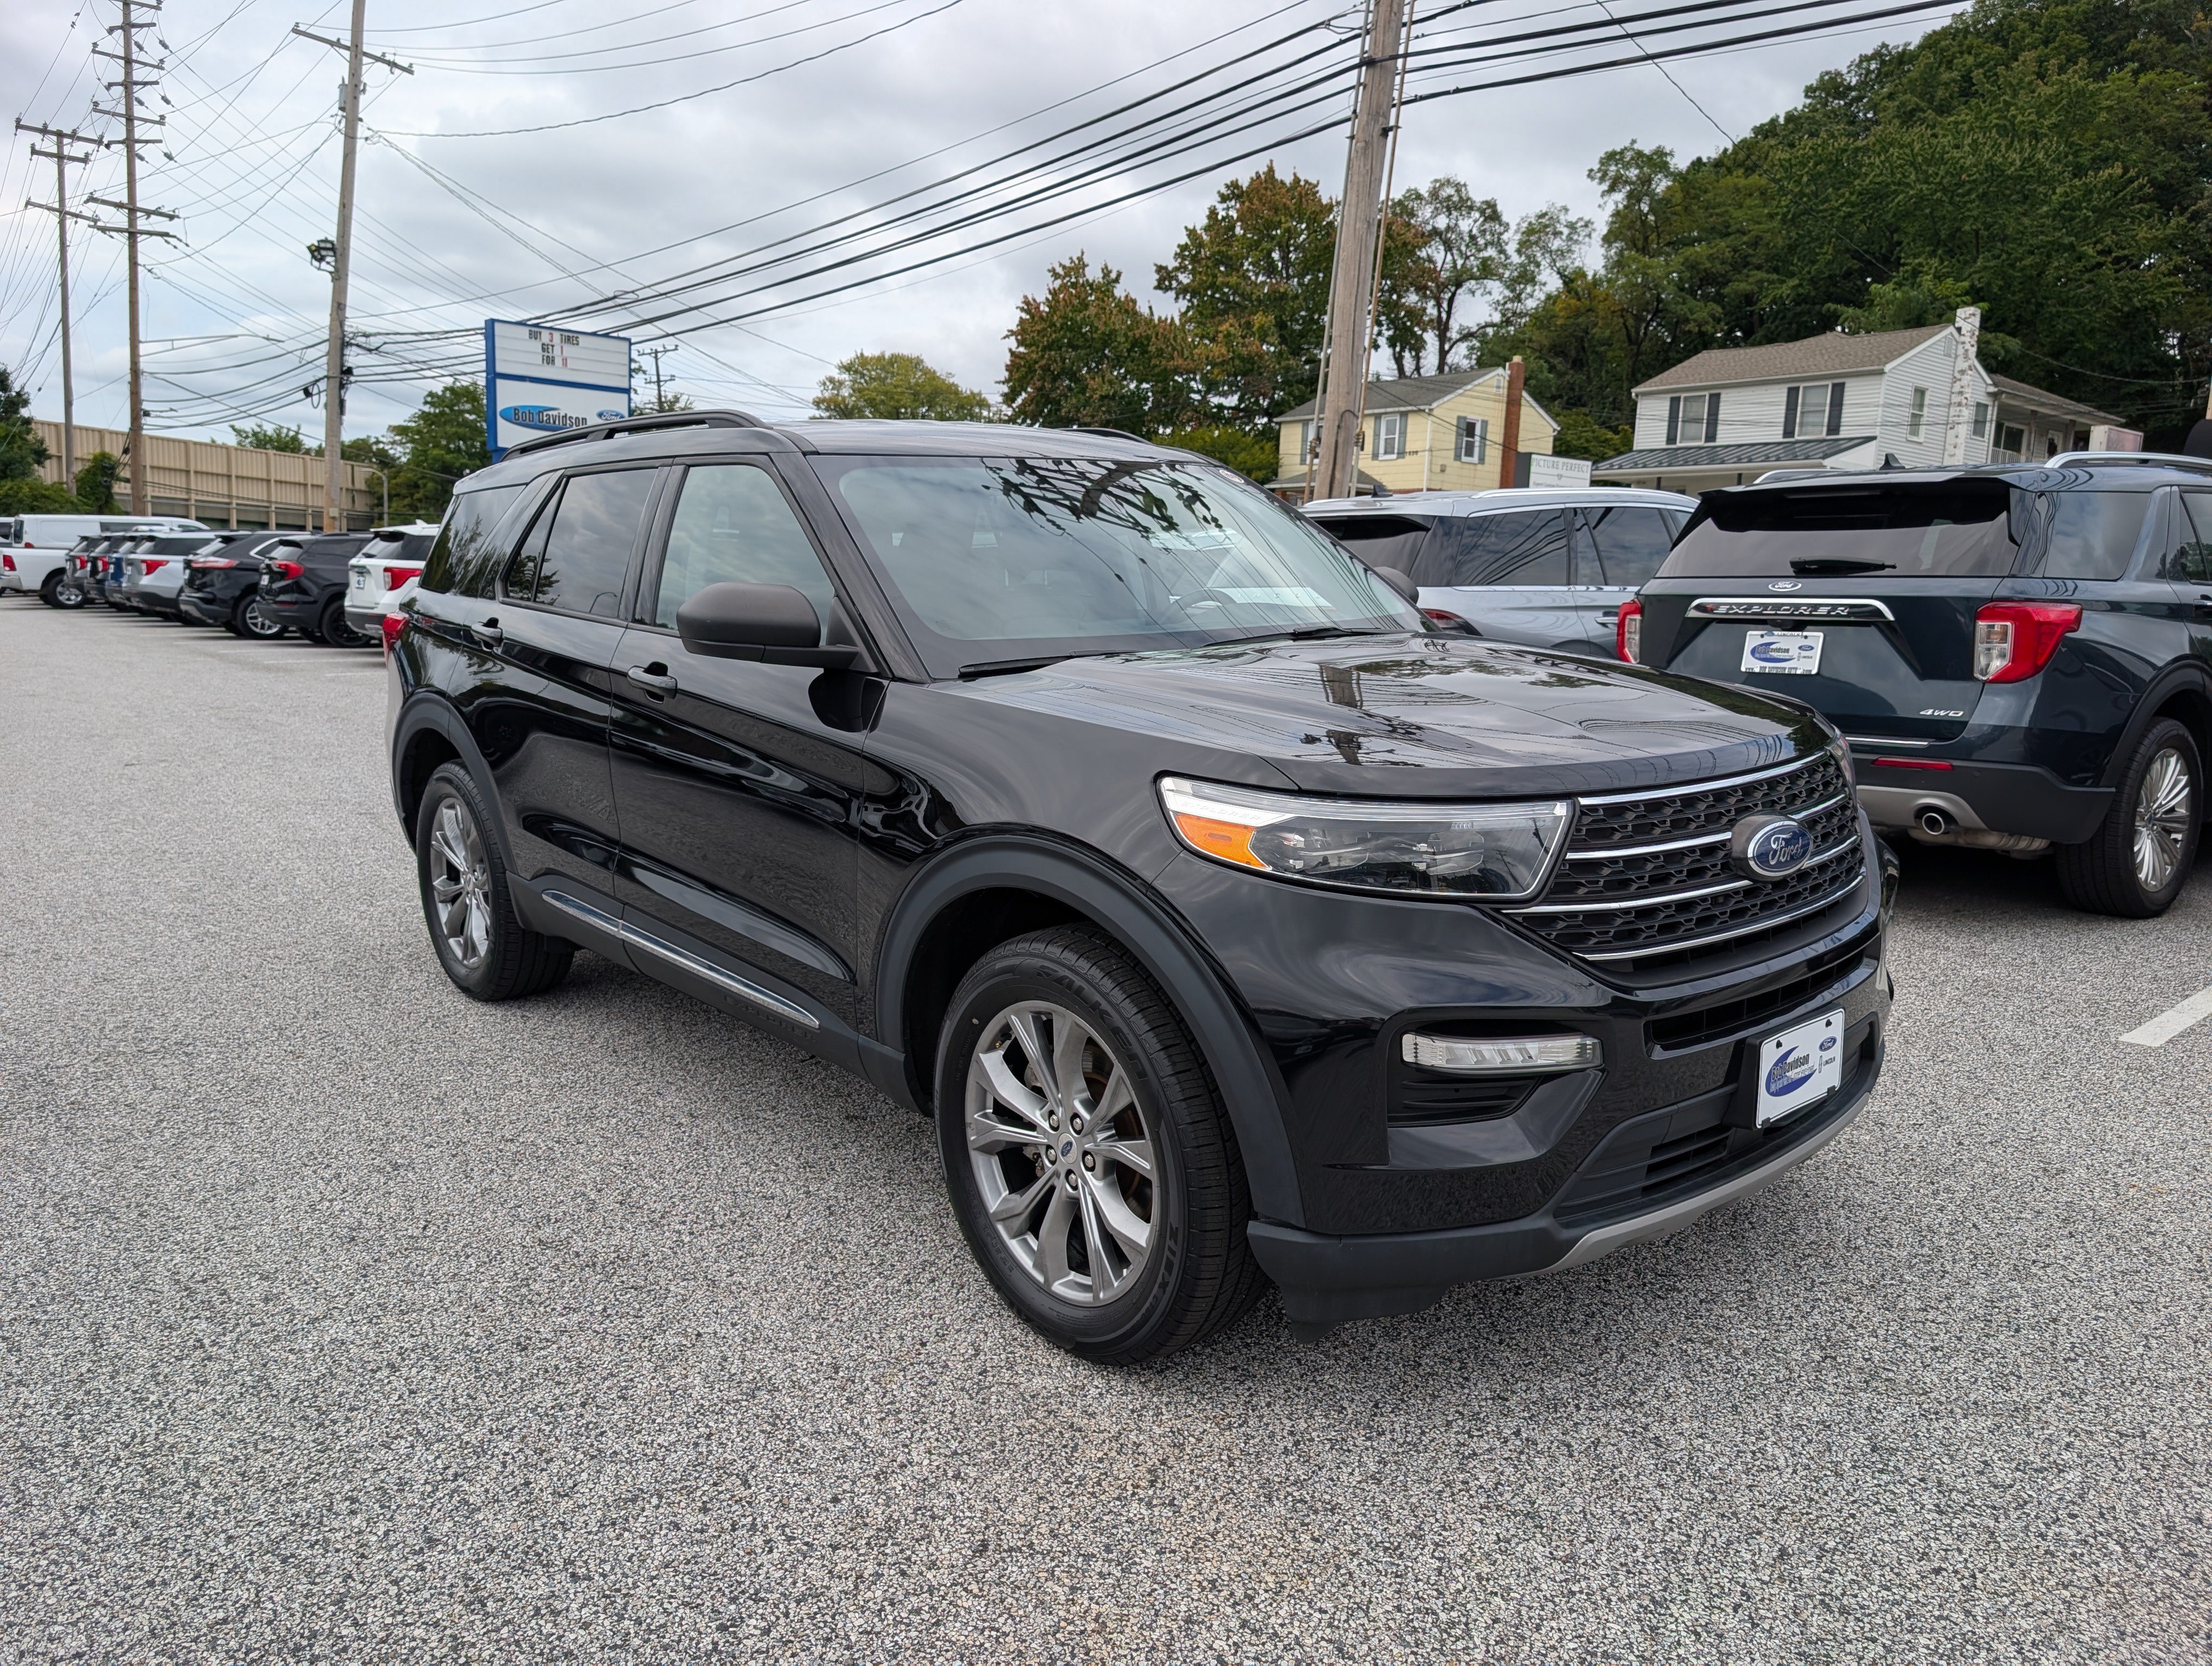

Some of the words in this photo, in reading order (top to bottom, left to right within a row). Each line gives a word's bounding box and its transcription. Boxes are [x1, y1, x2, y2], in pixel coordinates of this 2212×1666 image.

[529, 329, 542, 341] BUY
[549, 332, 554, 343] 3
[560, 333, 580, 345] TIRES
[541, 343, 555, 354] GET
[542, 355, 556, 366] FOR
[513, 407, 533, 422] Bob
[537, 410, 587, 427] Davidson
[602, 411, 620, 421] Ford
[1531, 458, 1560, 470] PICTURE
[1561, 461, 1590, 473] PERFECT
[1713, 605, 1849, 616] EXPLORER
[1919, 708, 1964, 717] 4WD
[1181, 801, 1262, 820] EXPLORER
[1769, 832, 1803, 864] Ford
[1033, 965, 1148, 1081] FALKEN
[1822, 1039, 1834, 1050] Ford
[1771, 1065, 1783, 1080] Bob
[1783, 1054, 1810, 1074] Davidson
